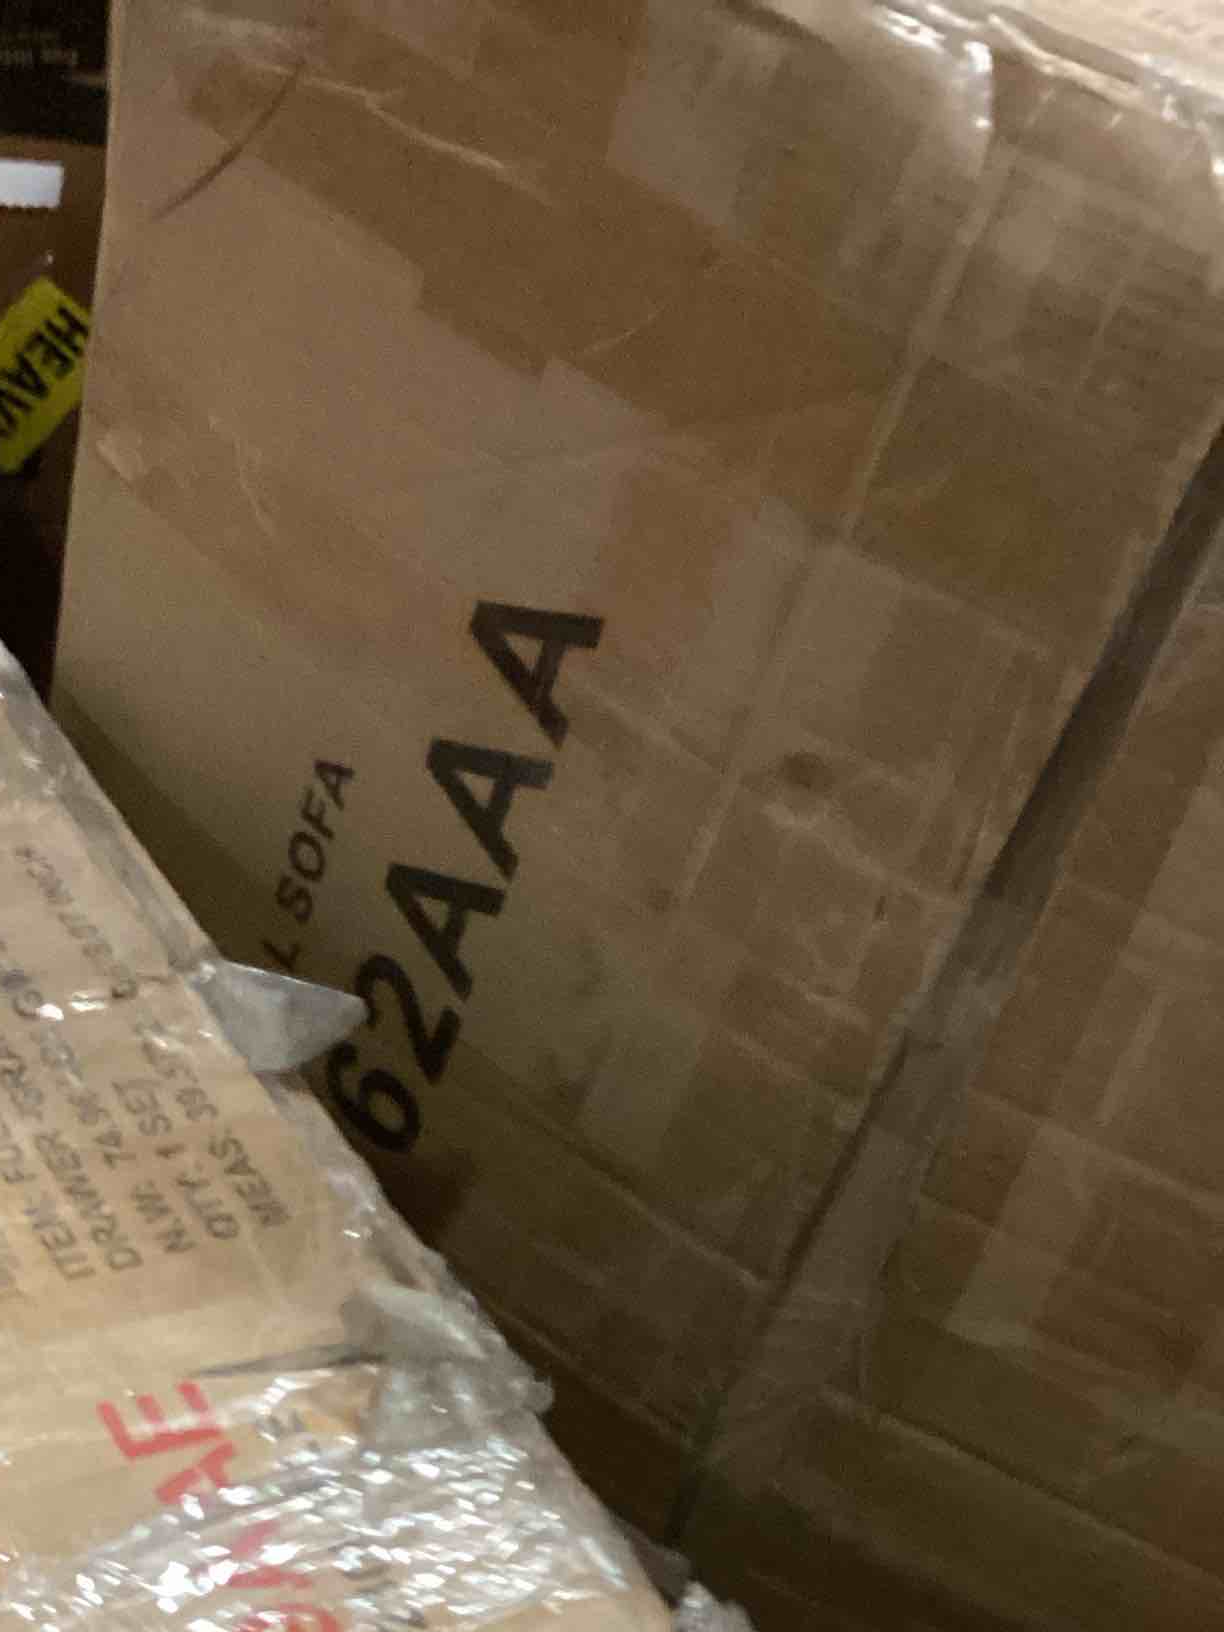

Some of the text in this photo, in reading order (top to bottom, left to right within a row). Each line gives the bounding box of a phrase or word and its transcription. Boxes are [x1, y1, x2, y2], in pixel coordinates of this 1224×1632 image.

[276, 758, 356, 923] SOFA
[325, 600, 605, 1154] 62AAA
[113, 1079, 173, 1137] SET
